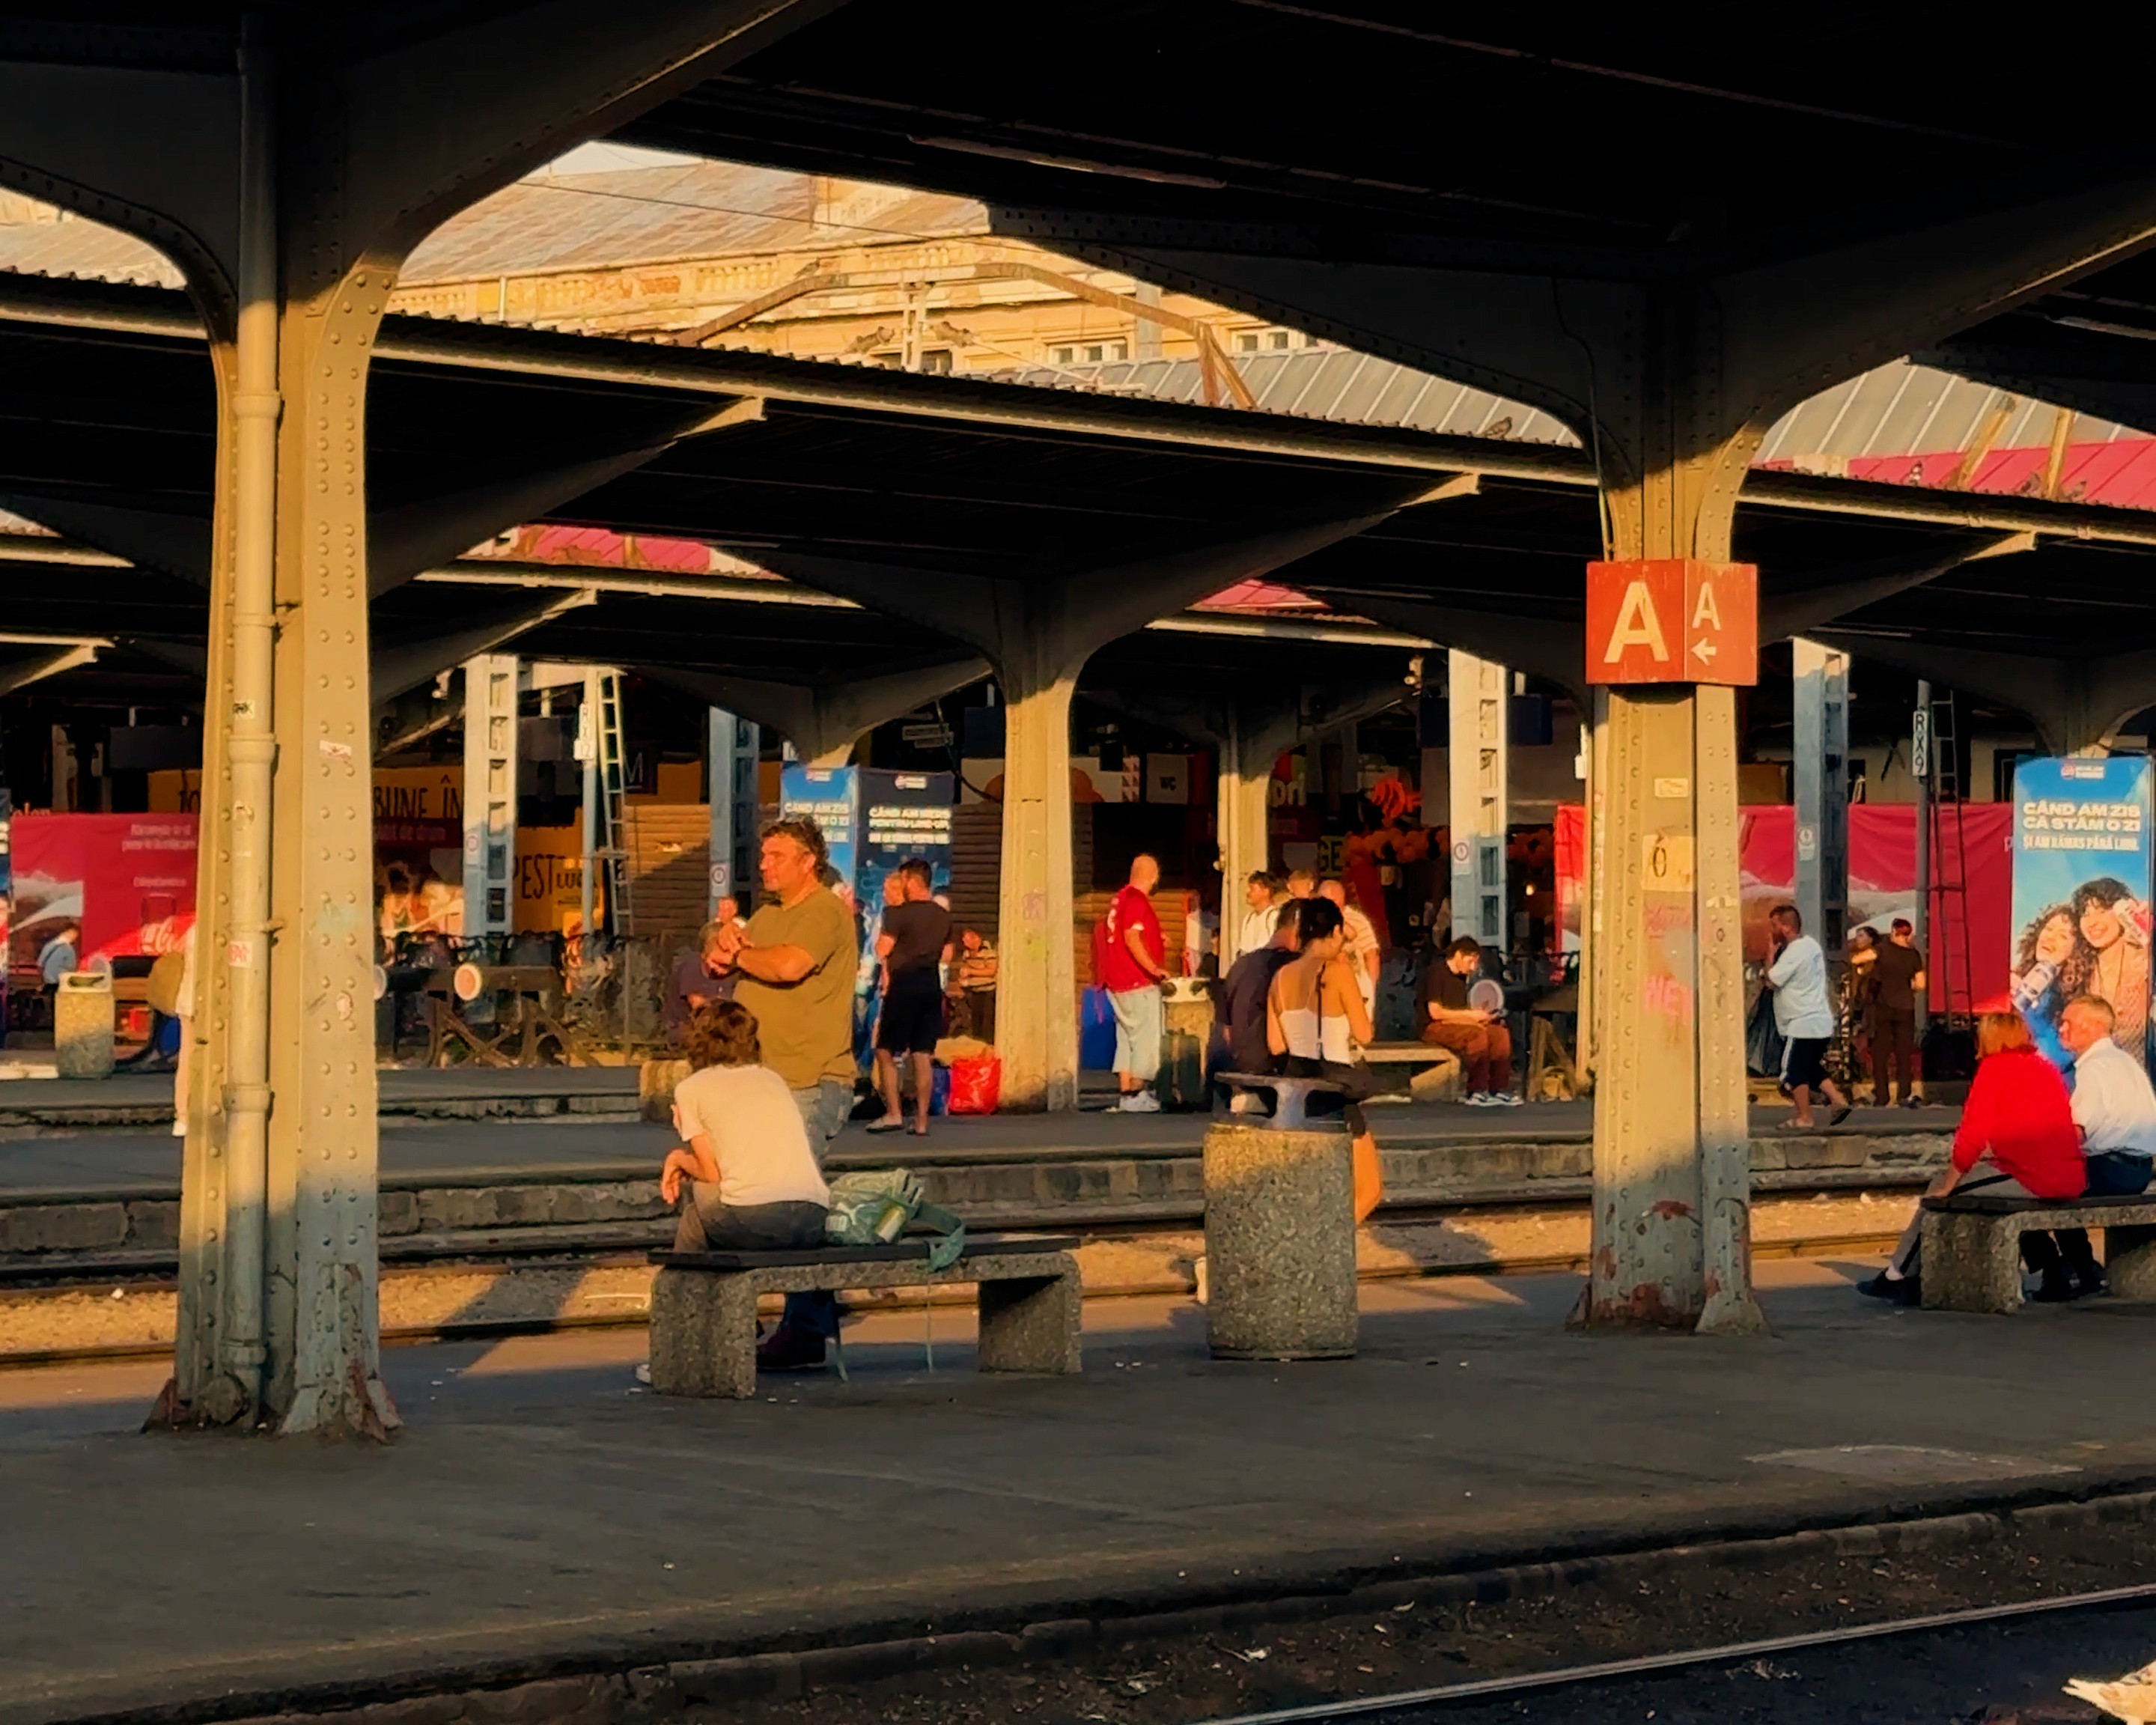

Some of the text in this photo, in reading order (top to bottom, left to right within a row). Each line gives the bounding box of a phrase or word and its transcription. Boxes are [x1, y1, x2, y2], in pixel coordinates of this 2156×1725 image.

[1604, 581, 1669, 663] A
[1692, 582, 1721, 630] A
[1915, 714, 1925, 773] RX9
[2023, 800, 2140, 818] CÂND AM ZIS
[2107, 819, 2121, 831] O
[2123, 819, 2140, 832] ZI
